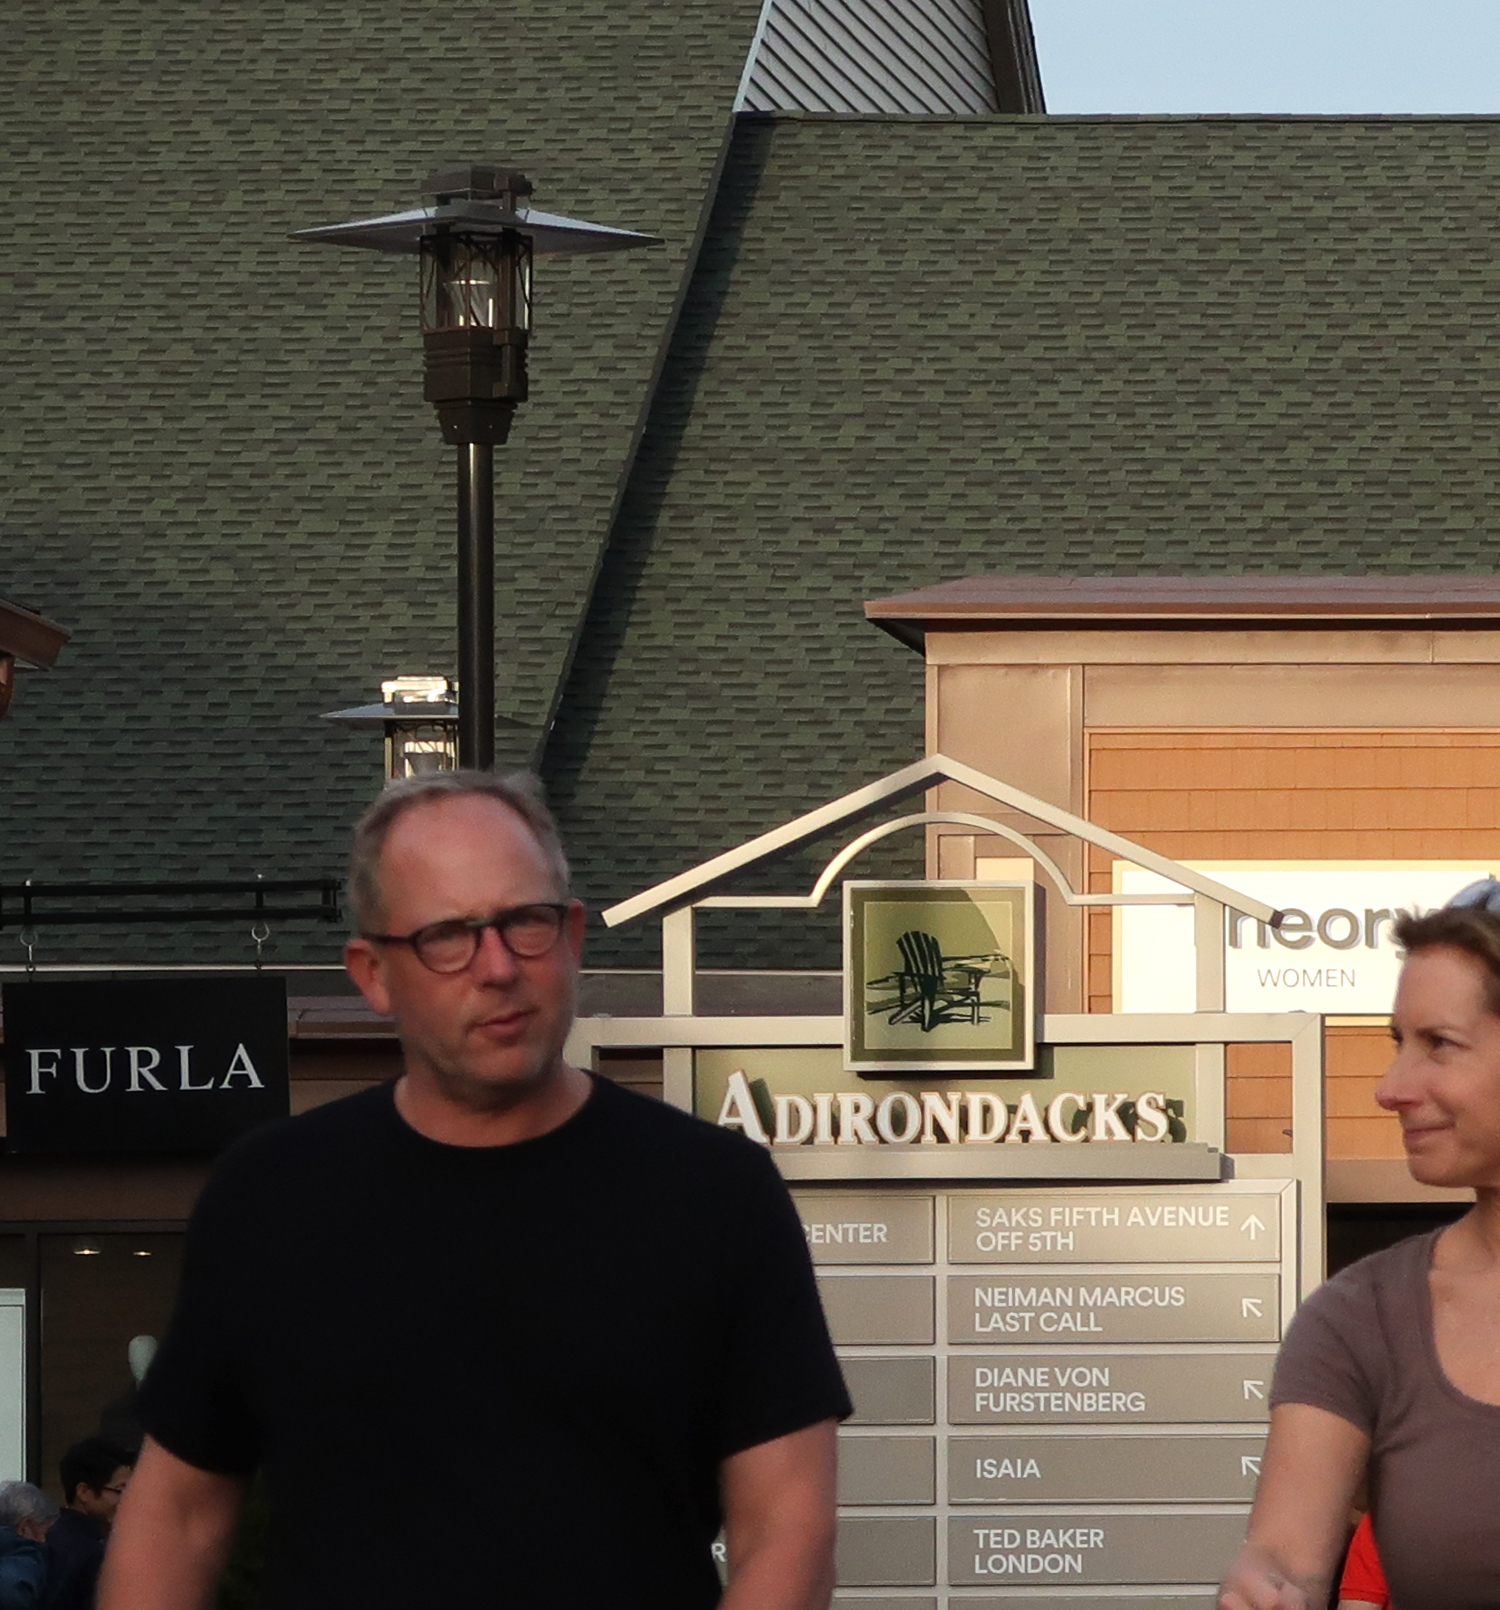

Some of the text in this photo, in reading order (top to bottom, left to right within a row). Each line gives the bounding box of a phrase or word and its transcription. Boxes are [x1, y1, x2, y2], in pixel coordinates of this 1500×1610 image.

[1256, 967, 1356, 988] WOMEN
[25, 1043, 265, 1094] FURLA
[717, 1069, 1170, 1146] ADIRONDACKS
[976, 1206, 1229, 1227] SAKS FIFTH AVENUE
[976, 1231, 1074, 1252] OFF 5TH
[974, 1286, 1185, 1307] NEIMAN MARCUS
[974, 1312, 1103, 1332] LAST CALL
[975, 1366, 1110, 1387] DIANE VON
[975, 1392, 1146, 1412] FURSTENBERG
[975, 1458, 1042, 1478] ISAIA
[973, 1528, 1104, 1549] TED BAKER
[974, 1554, 1082, 1574] LONDON
